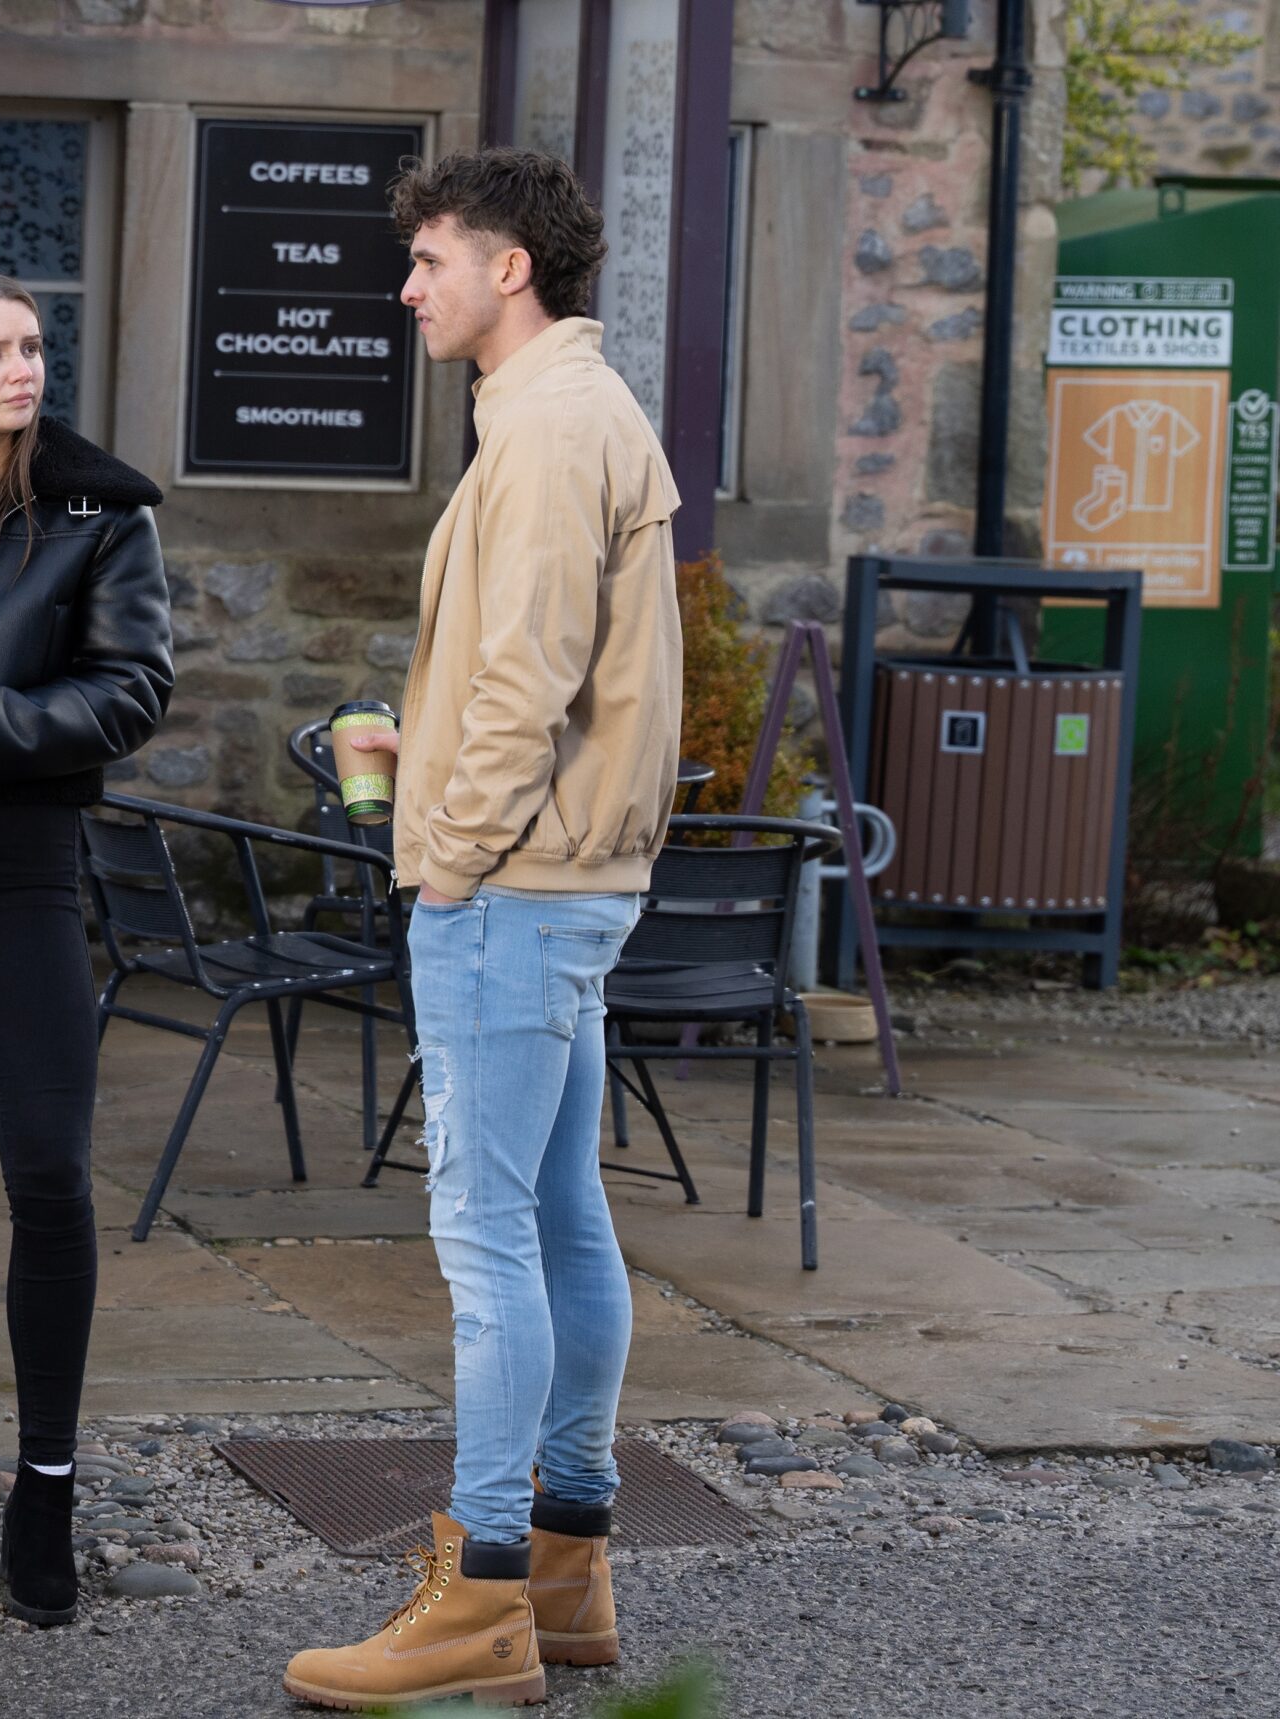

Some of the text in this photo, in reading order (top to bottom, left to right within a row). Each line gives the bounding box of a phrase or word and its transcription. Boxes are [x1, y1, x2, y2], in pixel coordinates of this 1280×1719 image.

[250, 162, 370, 186] COFFEES
[272, 243, 340, 264] TEAS
[1060, 283, 1135, 299] WARNING
[277, 308, 332, 328] HOT
[1058, 315, 1222, 339] CLOTHING
[216, 333, 390, 358] CHOCOLATES
[1058, 340, 1220, 358] TEXTILES & SHOES
[236, 406, 363, 427] SMOOTHIES
[1237, 422, 1269, 440] YES
